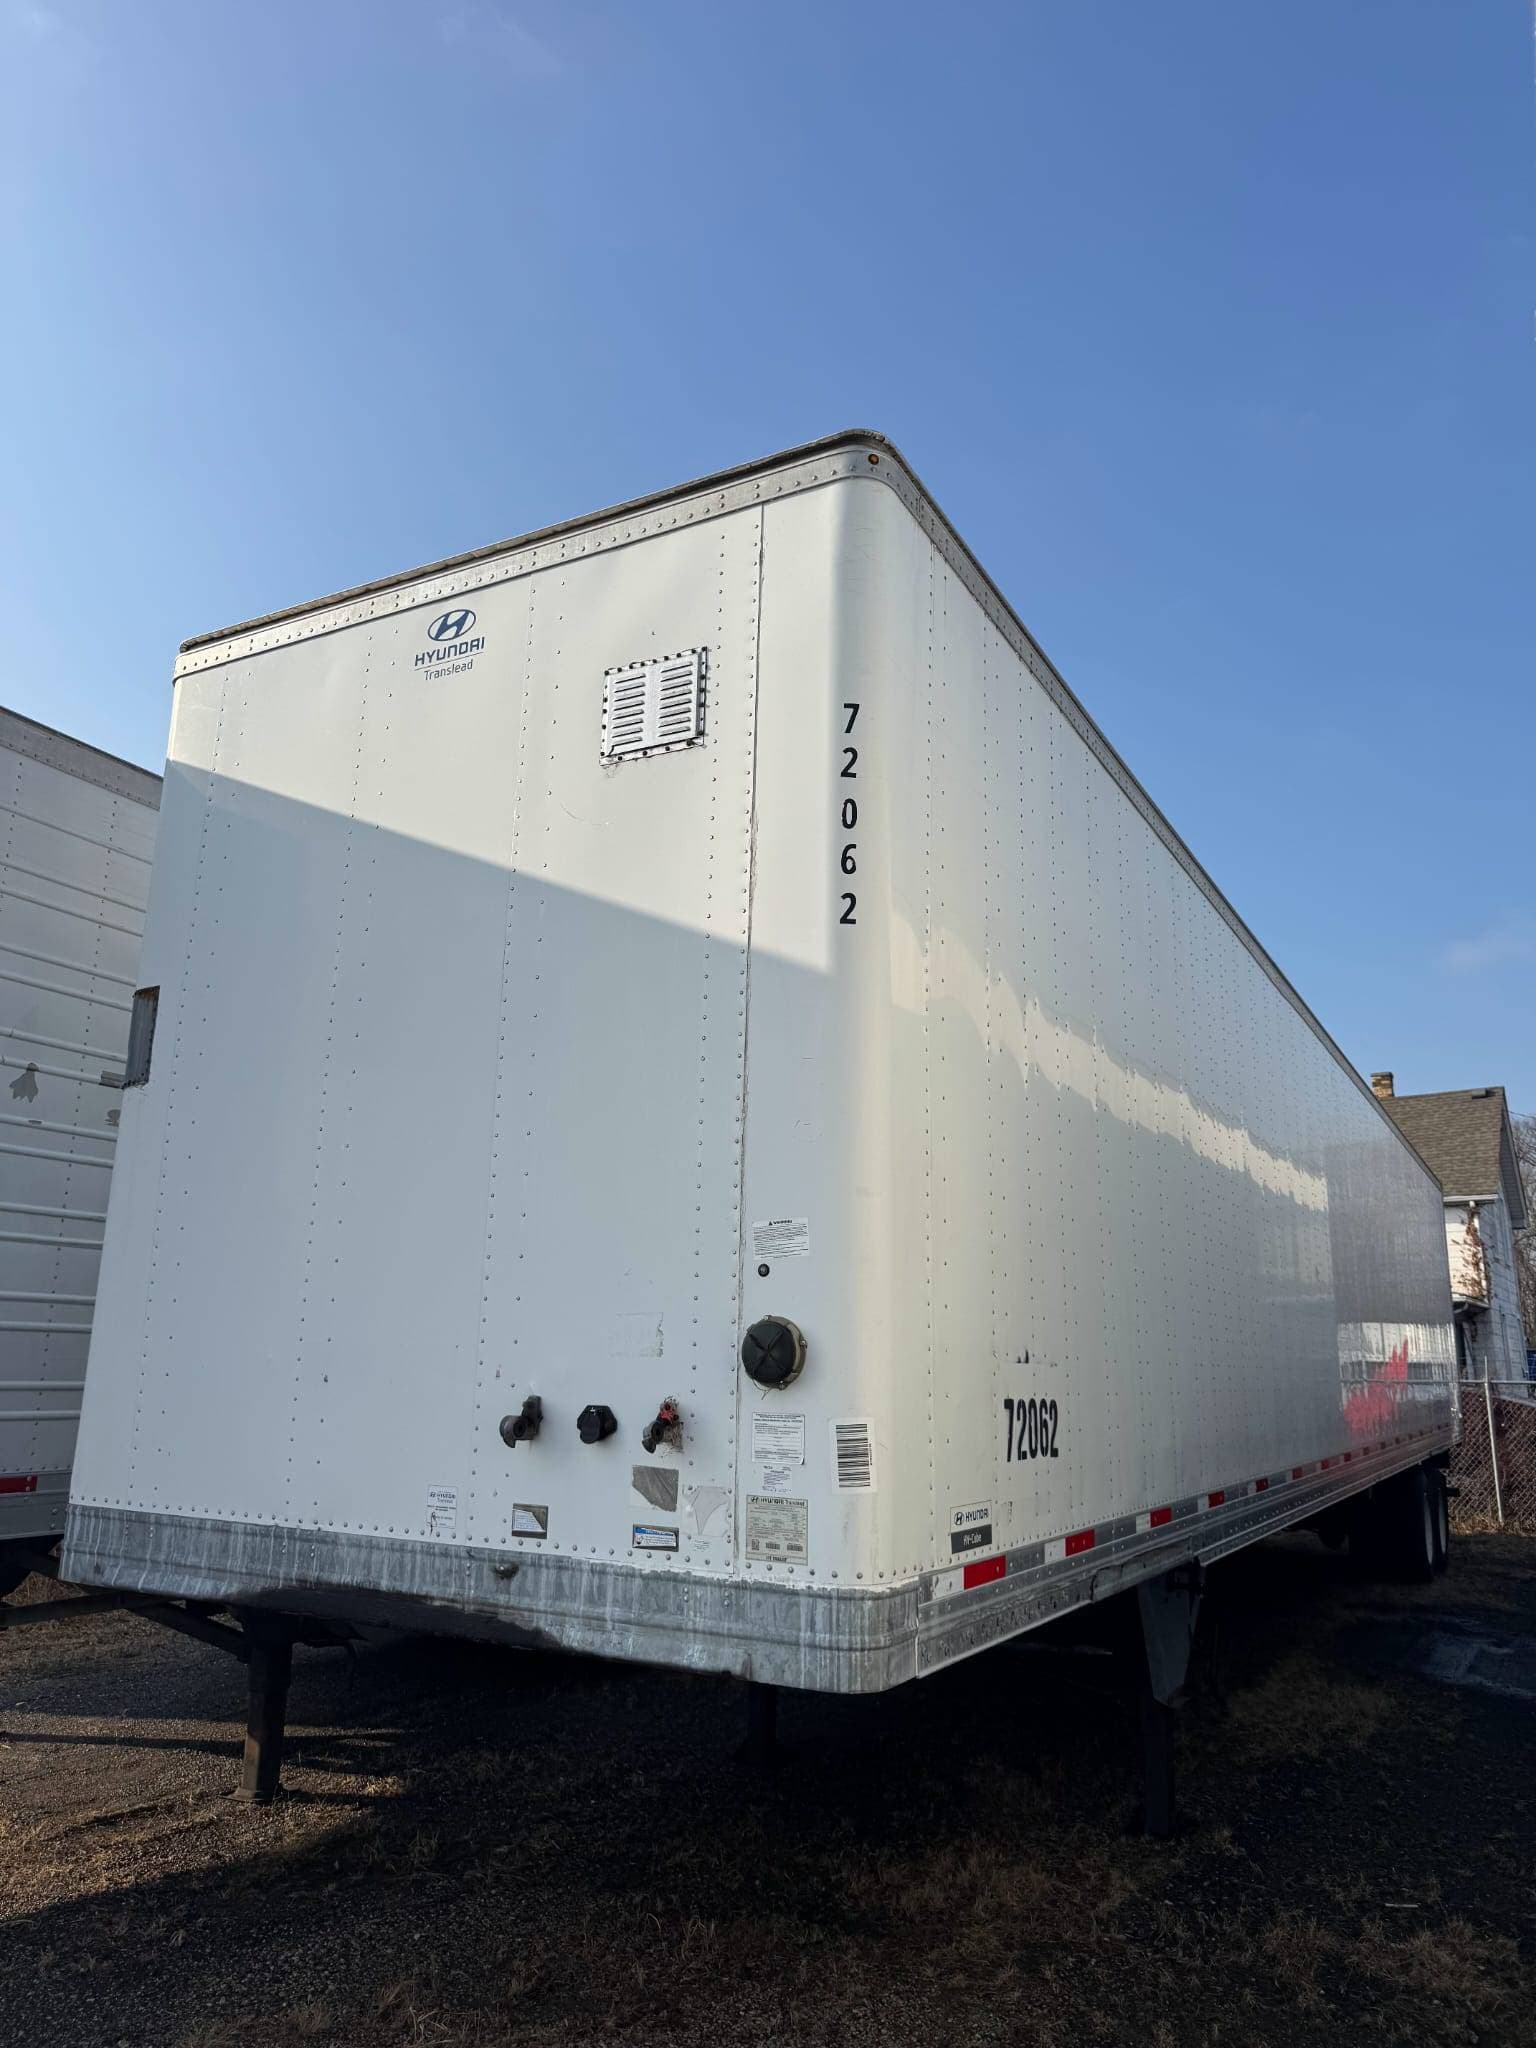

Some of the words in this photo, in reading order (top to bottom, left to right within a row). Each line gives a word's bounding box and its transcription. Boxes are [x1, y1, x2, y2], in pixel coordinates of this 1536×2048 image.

[415, 636, 485, 667] HYUNDAI
[424, 659, 474, 681] Translead
[840, 703, 860, 925] 72062
[1004, 1398, 1059, 1462] 72062
